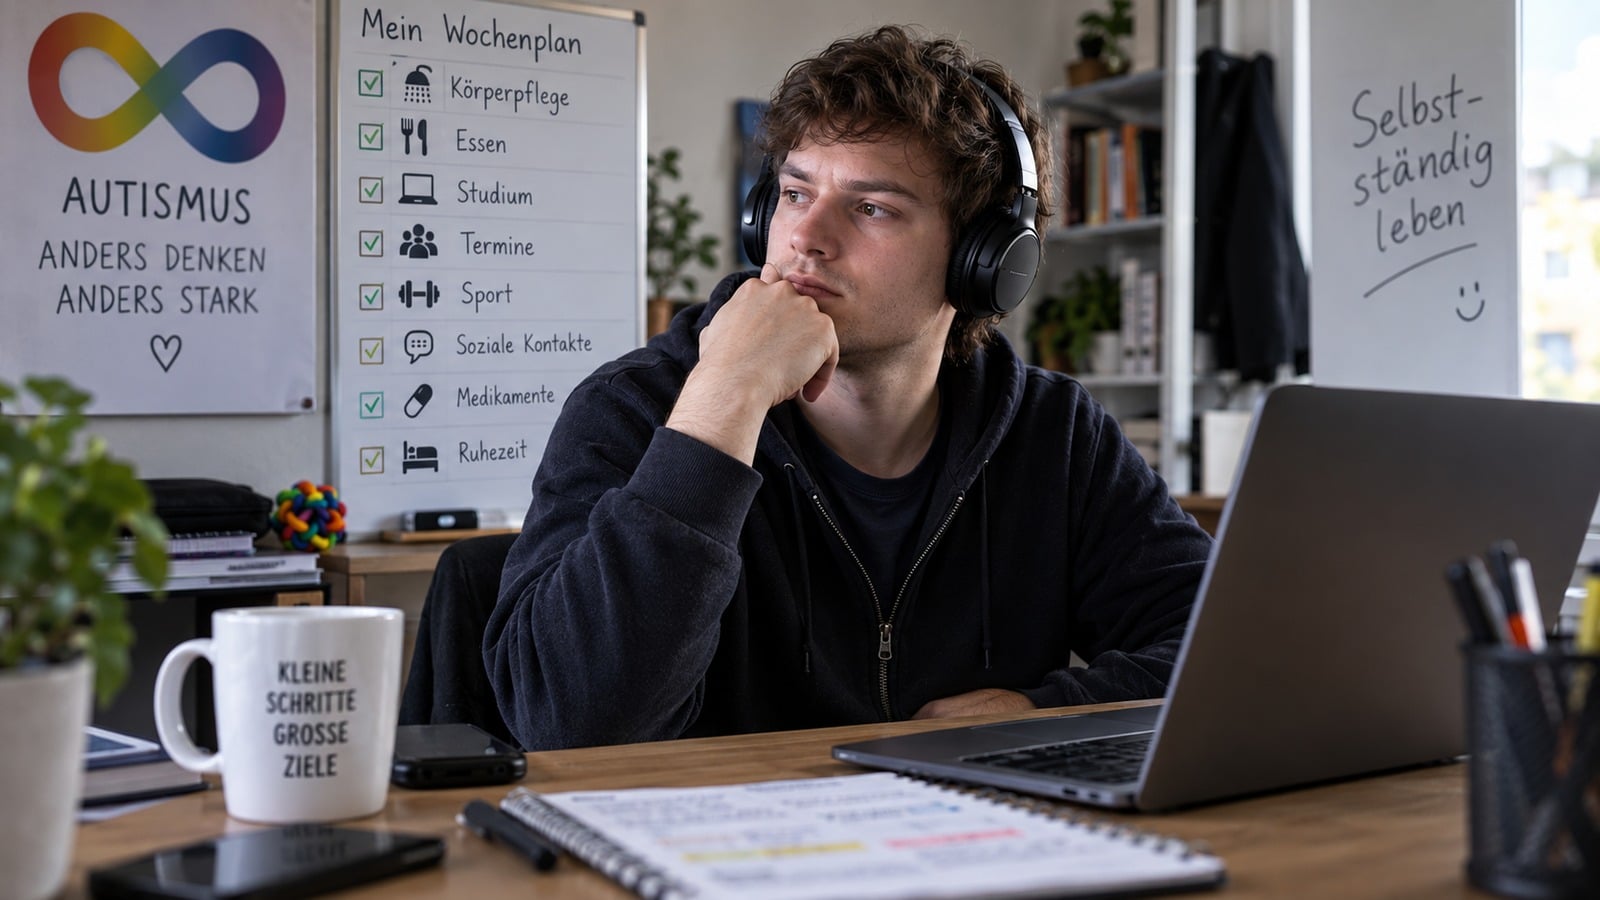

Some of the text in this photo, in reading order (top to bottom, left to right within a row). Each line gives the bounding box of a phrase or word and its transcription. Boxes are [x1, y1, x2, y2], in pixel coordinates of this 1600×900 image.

[361, 7, 582, 63] Mein Wochenplan
[450, 75, 570, 116] Körperpflege
[1352, 73, 1483, 148] Selbst-
[456, 128, 507, 154] Essen
[1353, 130, 1493, 206] ständig
[62, 176, 251, 225] AUTISMUS
[457, 179, 533, 206] Studium
[1377, 197, 1465, 253] leben
[38, 239, 266, 273] ANDERS DENKEN
[460, 231, 535, 256] Termine
[55, 283, 259, 315] ANDERS STARK
[461, 280, 513, 314] Sport
[456, 331, 593, 356] Soziale Kontakte
[456, 384, 555, 408] Medikamente
[458, 439, 528, 464] Ruhezeit
[278, 658, 347, 685] KLEINE
[266, 689, 358, 715] SCHRITTE
[273, 720, 349, 746] GROSSE
[283, 752, 339, 779] ZIELE
